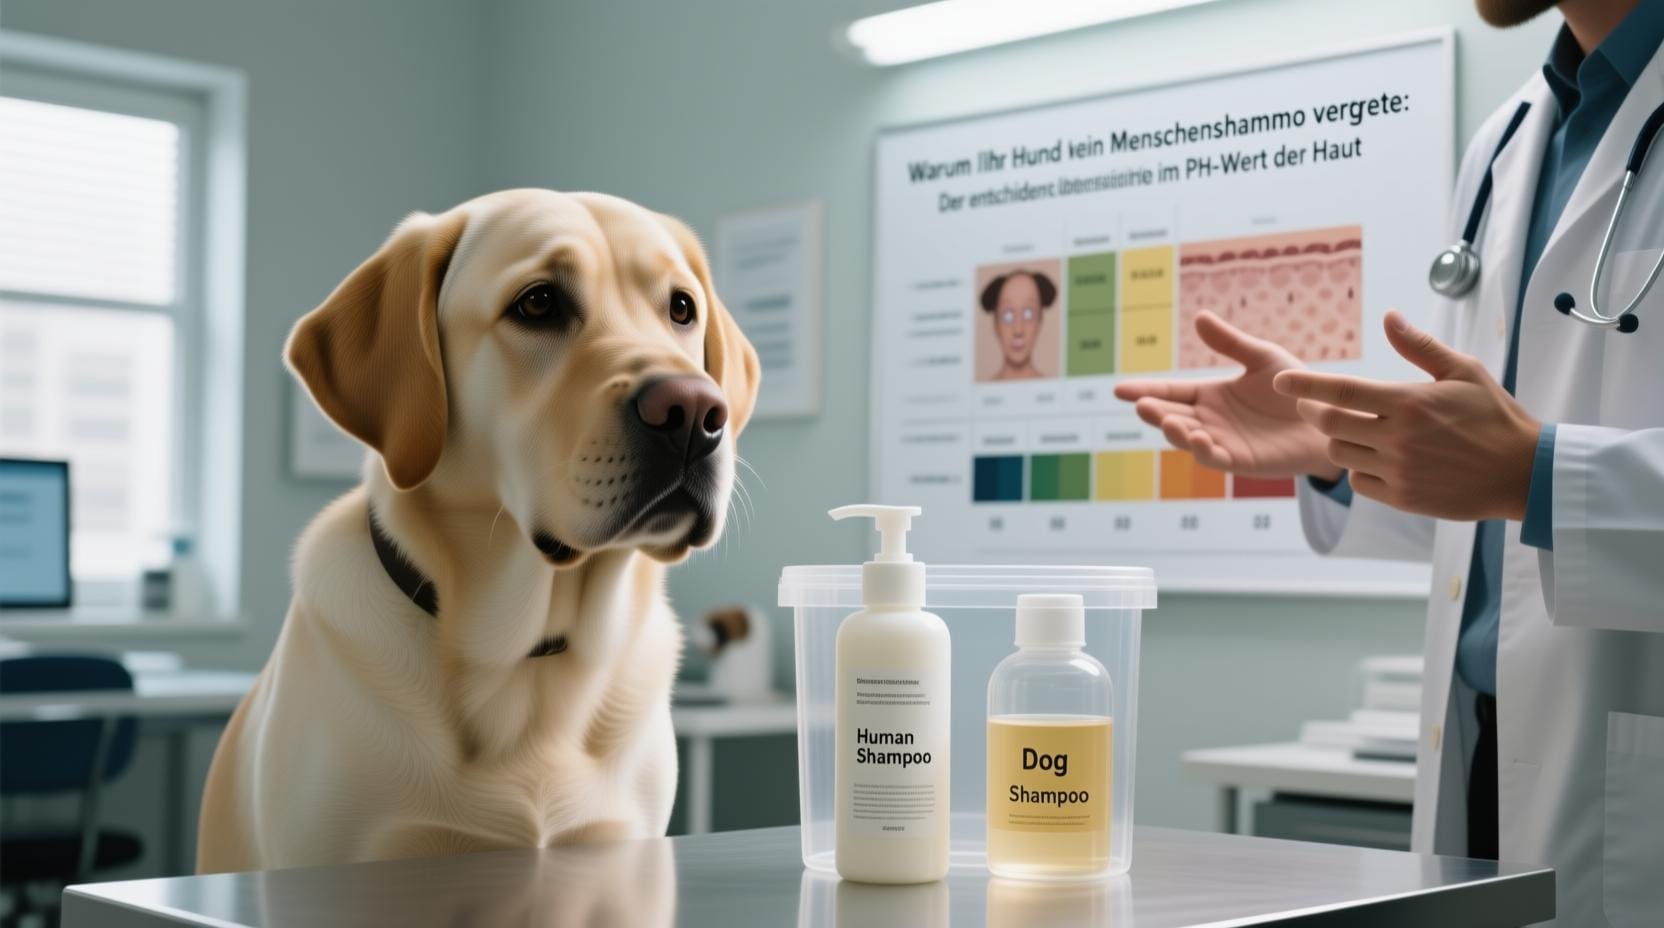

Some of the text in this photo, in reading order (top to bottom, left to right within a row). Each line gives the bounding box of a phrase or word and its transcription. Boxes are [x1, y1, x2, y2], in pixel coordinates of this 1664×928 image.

[908, 159, 972, 183] Warum
[1012, 138, 1062, 169] Hund
[1110, 108, 1306, 154] Menschenshammo
[1313, 91, 1410, 127] vergete:
[938, 191, 965, 213] Der
[1158, 161, 1180, 184] im
[1185, 149, 1268, 180] PH-Wert
[1273, 144, 1307, 168] der
[1313, 136, 1362, 163] Haut
[857, 728, 914, 745] Human
[856, 748, 932, 768] Shampoo
[1022, 747, 1068, 777] Dog
[1009, 784, 1089, 808] Shampoo
